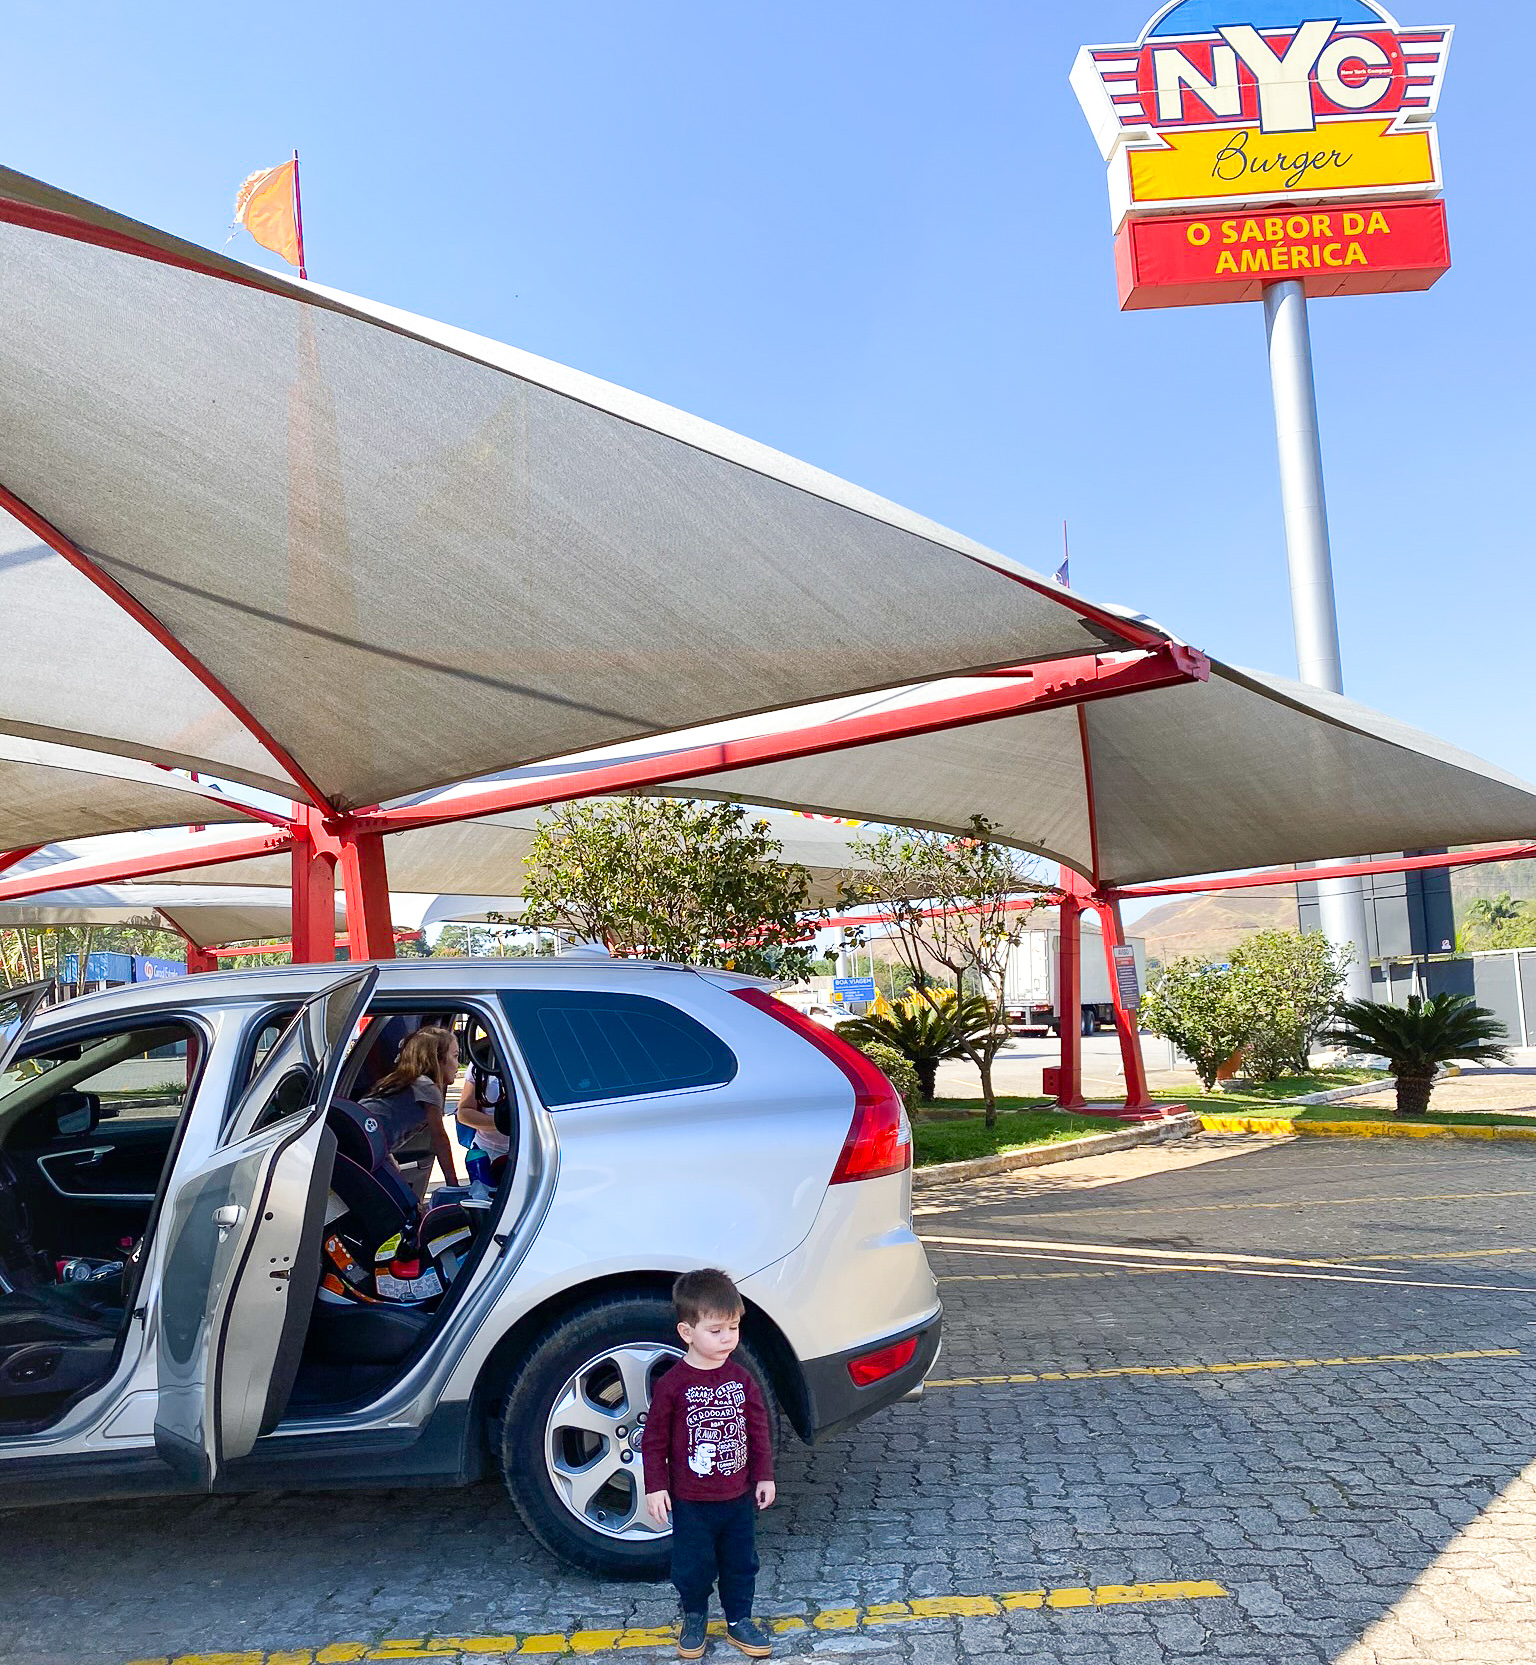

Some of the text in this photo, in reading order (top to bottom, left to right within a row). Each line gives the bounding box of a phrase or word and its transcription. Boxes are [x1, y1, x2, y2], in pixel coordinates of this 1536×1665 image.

[1153, 18, 1393, 134] NYC
[1367, 67, 1393, 75] Company
[1211, 131, 1353, 188] Burger
[1186, 211, 1391, 246] O SABOR DA
[1215, 241, 1368, 274] AMÉRICA
